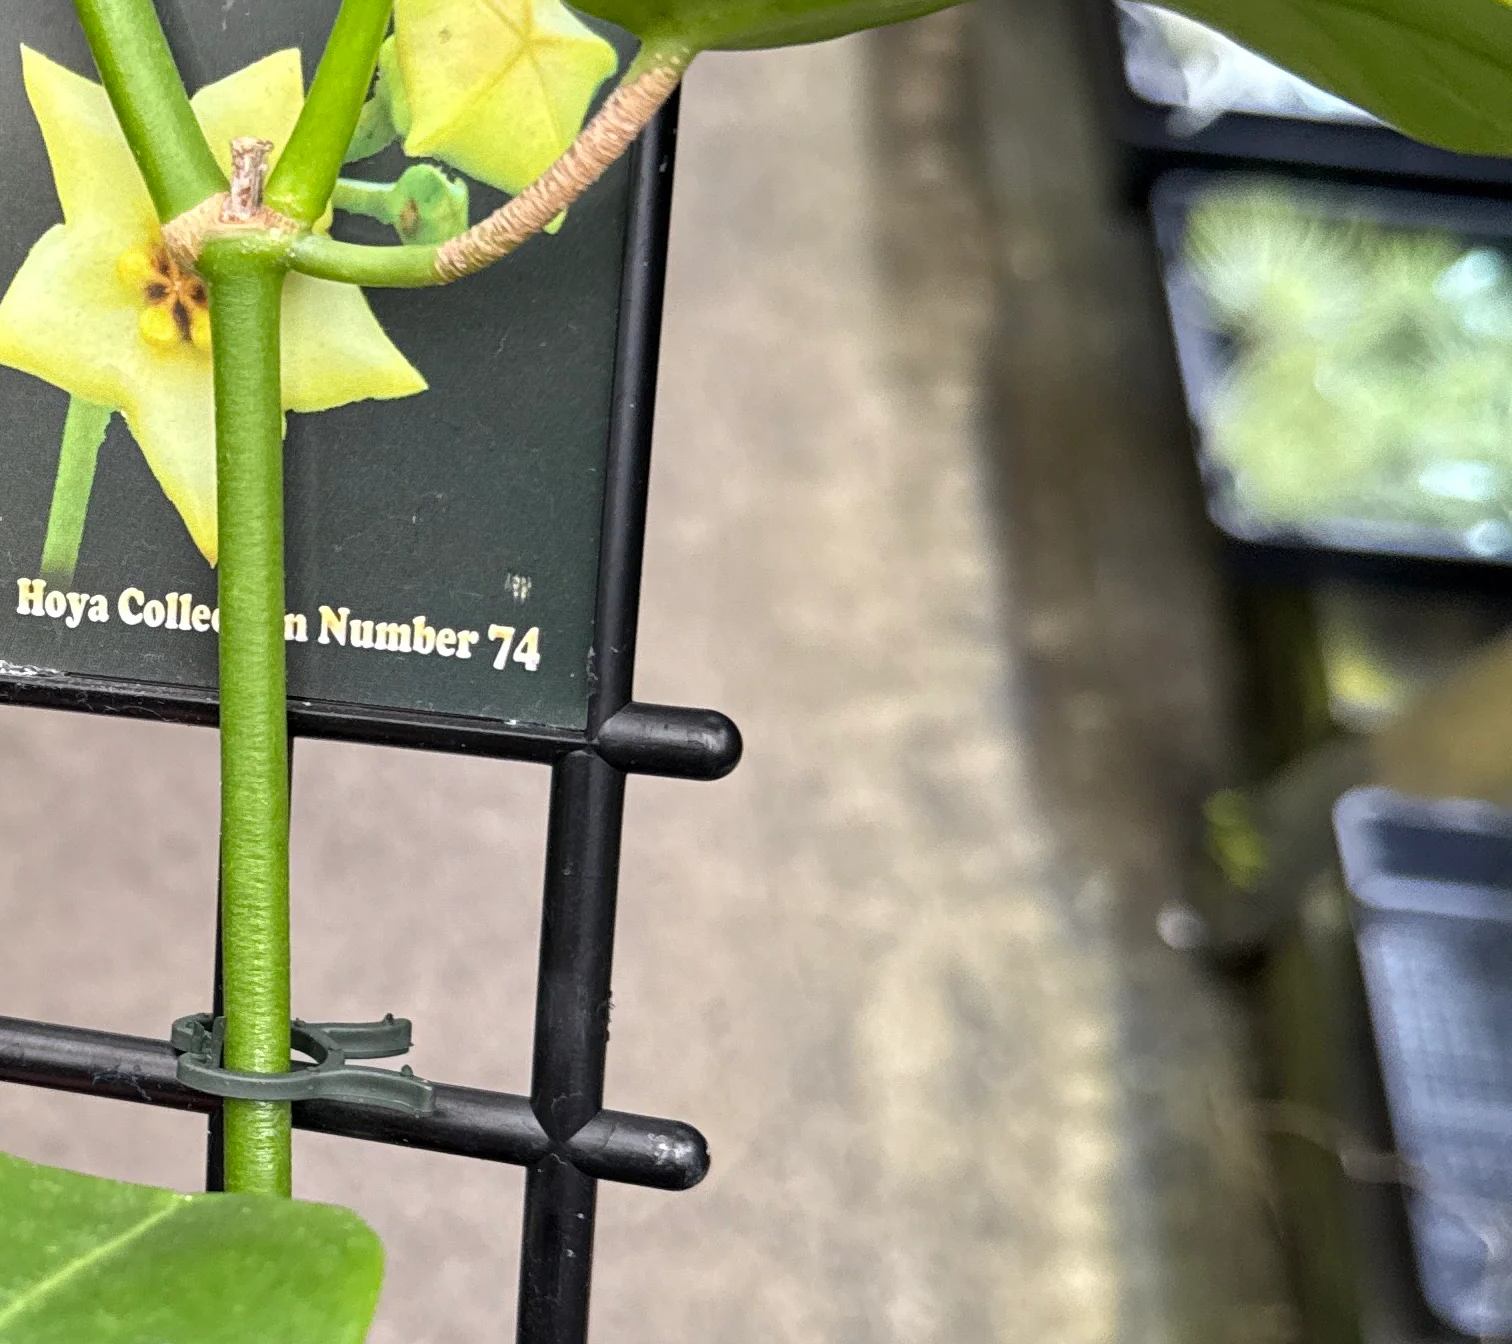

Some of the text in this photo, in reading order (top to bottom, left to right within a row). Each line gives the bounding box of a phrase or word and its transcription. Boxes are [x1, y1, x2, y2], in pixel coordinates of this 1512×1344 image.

[16, 577, 541, 672] Hoya Collen Number 74
